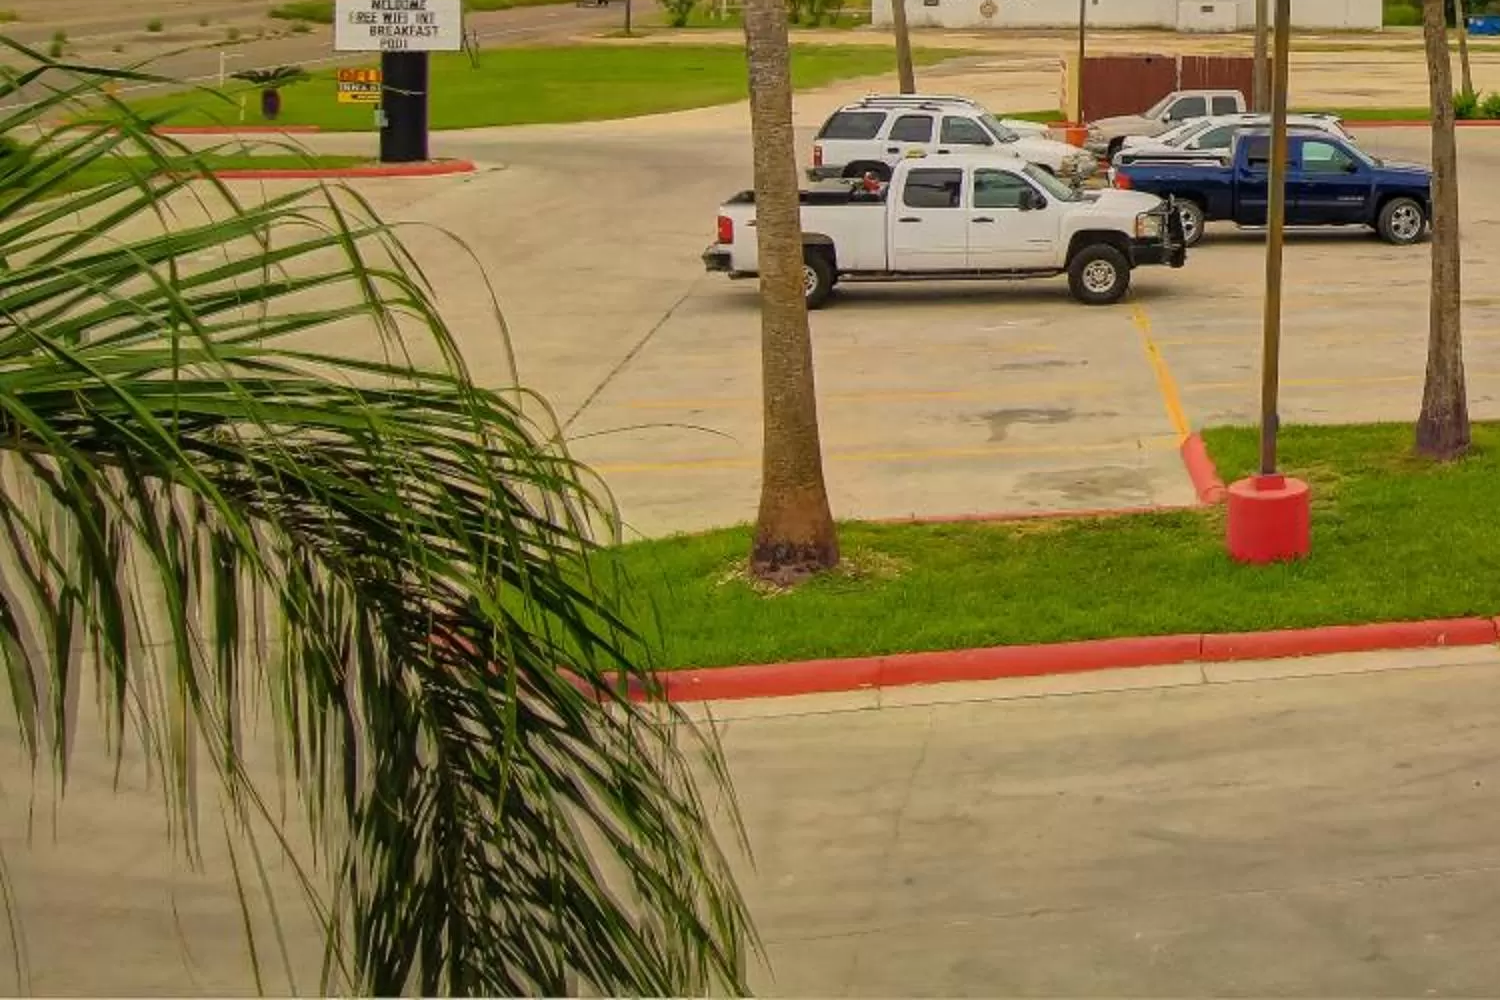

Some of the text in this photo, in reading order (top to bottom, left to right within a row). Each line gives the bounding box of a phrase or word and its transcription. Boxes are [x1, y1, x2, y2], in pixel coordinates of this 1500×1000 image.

[348, 10, 377, 24] FREE
[382, 11, 408, 24] WIFI
[369, 25, 439, 37] BREAKFAST
